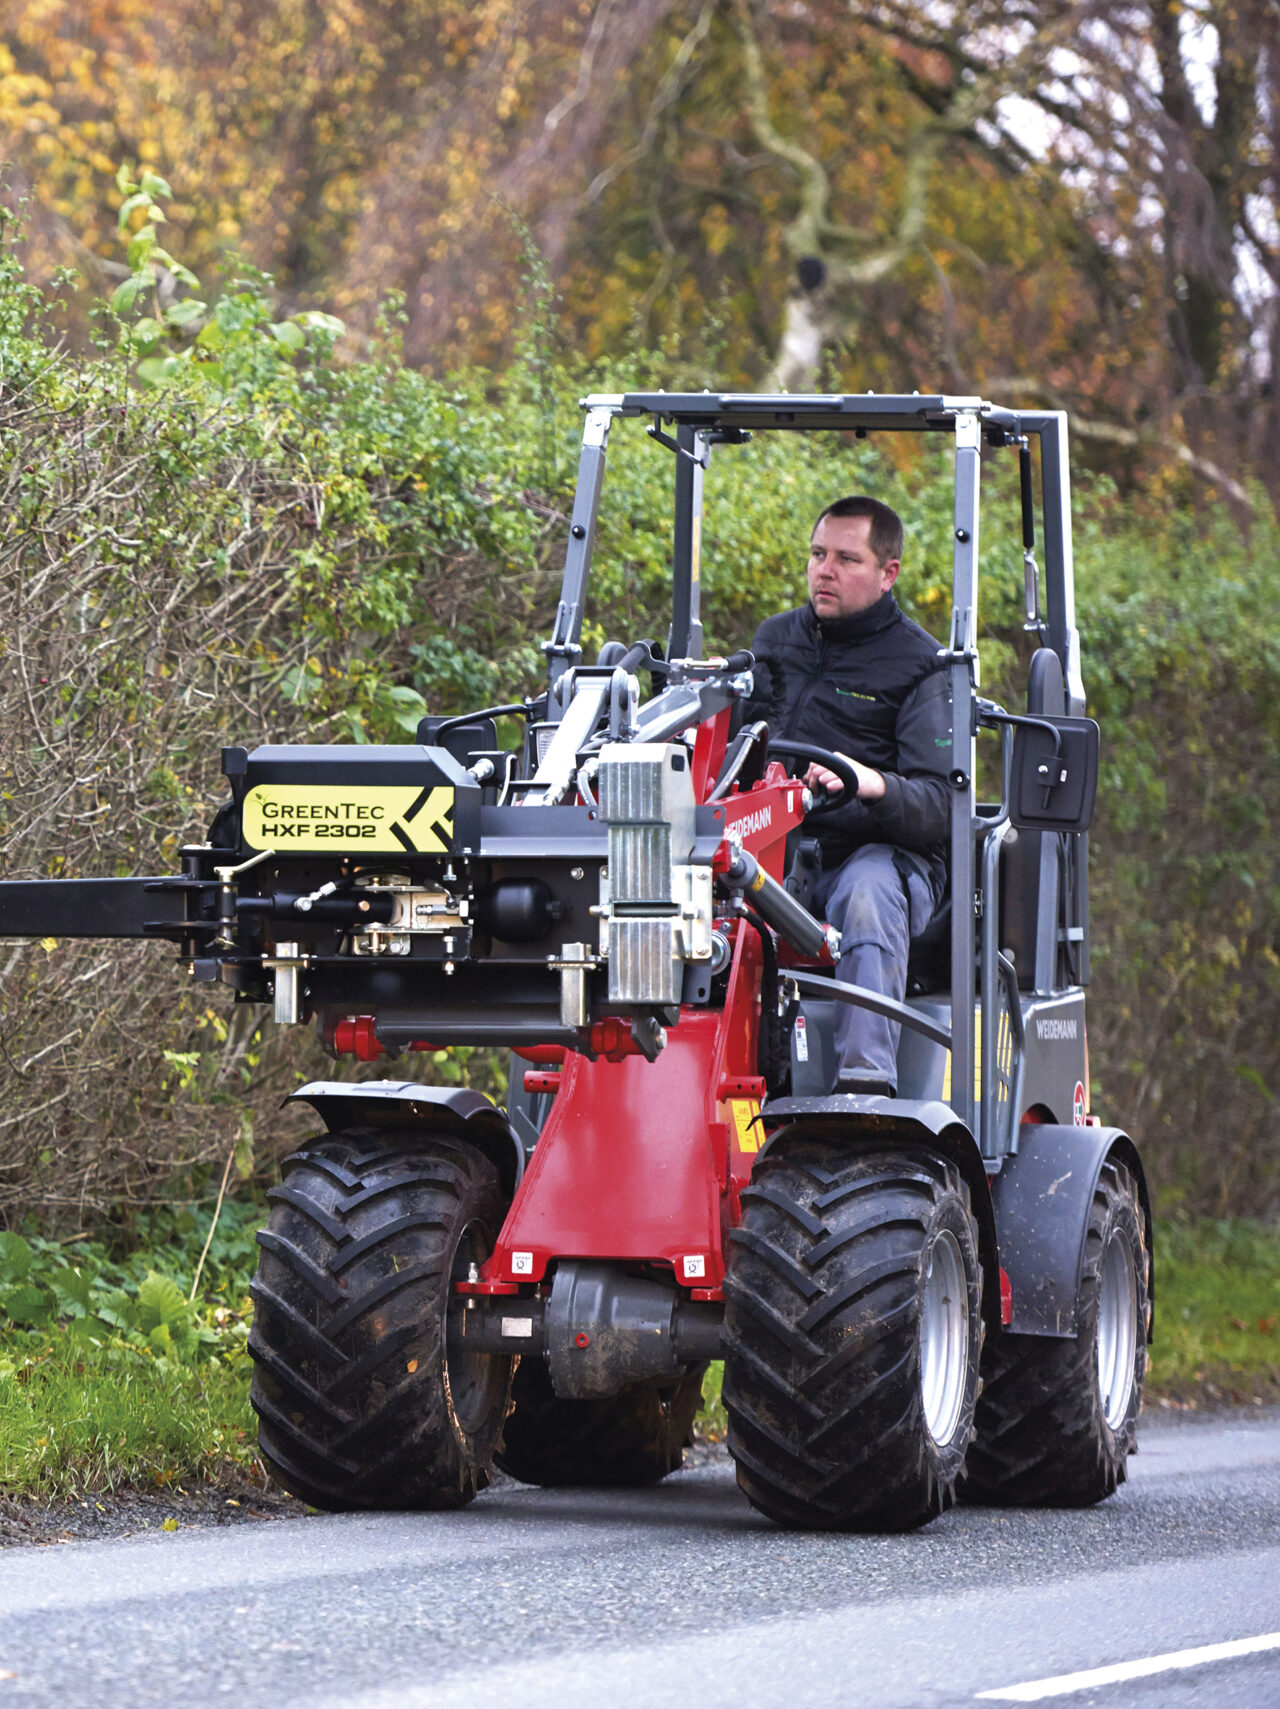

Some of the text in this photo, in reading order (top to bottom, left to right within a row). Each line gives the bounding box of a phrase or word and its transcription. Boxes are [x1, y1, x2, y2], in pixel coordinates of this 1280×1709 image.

[261, 823, 377, 838] HXF 2302
[725, 804, 772, 838] EIDEMANN
[1035, 1019, 1078, 1040] WEIDEMANN
